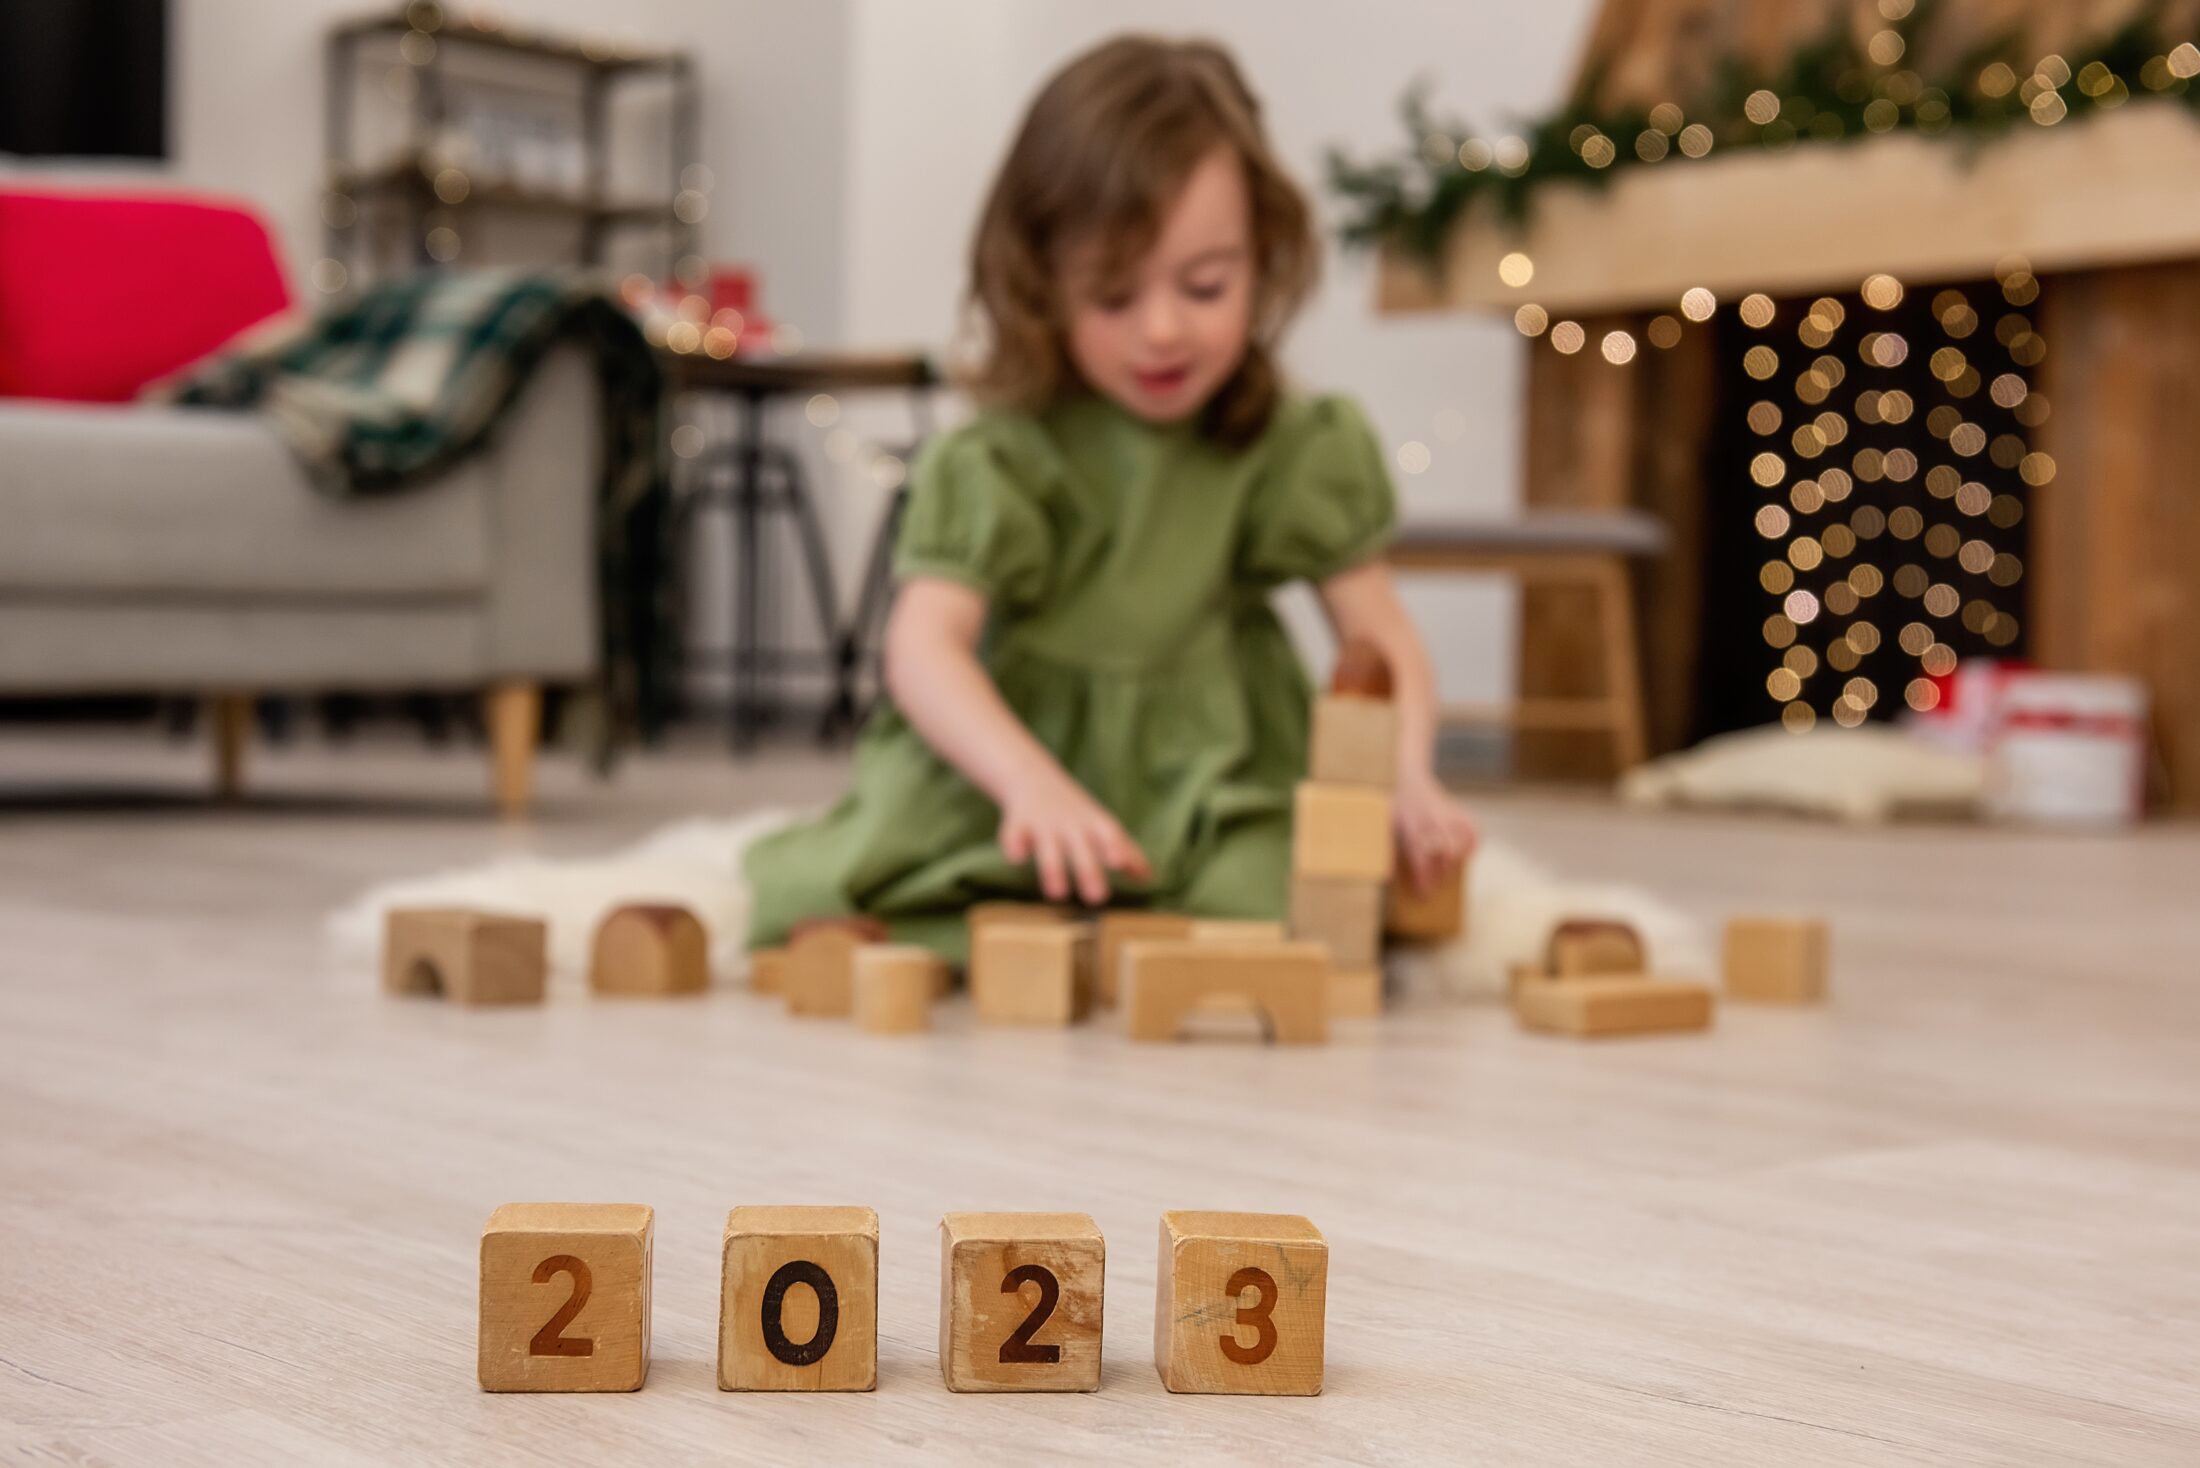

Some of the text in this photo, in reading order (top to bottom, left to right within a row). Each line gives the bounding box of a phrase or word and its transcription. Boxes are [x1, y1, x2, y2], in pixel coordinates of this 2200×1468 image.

[530, 1254, 593, 1356] 2
[761, 1260, 839, 1366] 0
[999, 1264, 1060, 1363] 2
[1219, 1266, 1278, 1365] 3
